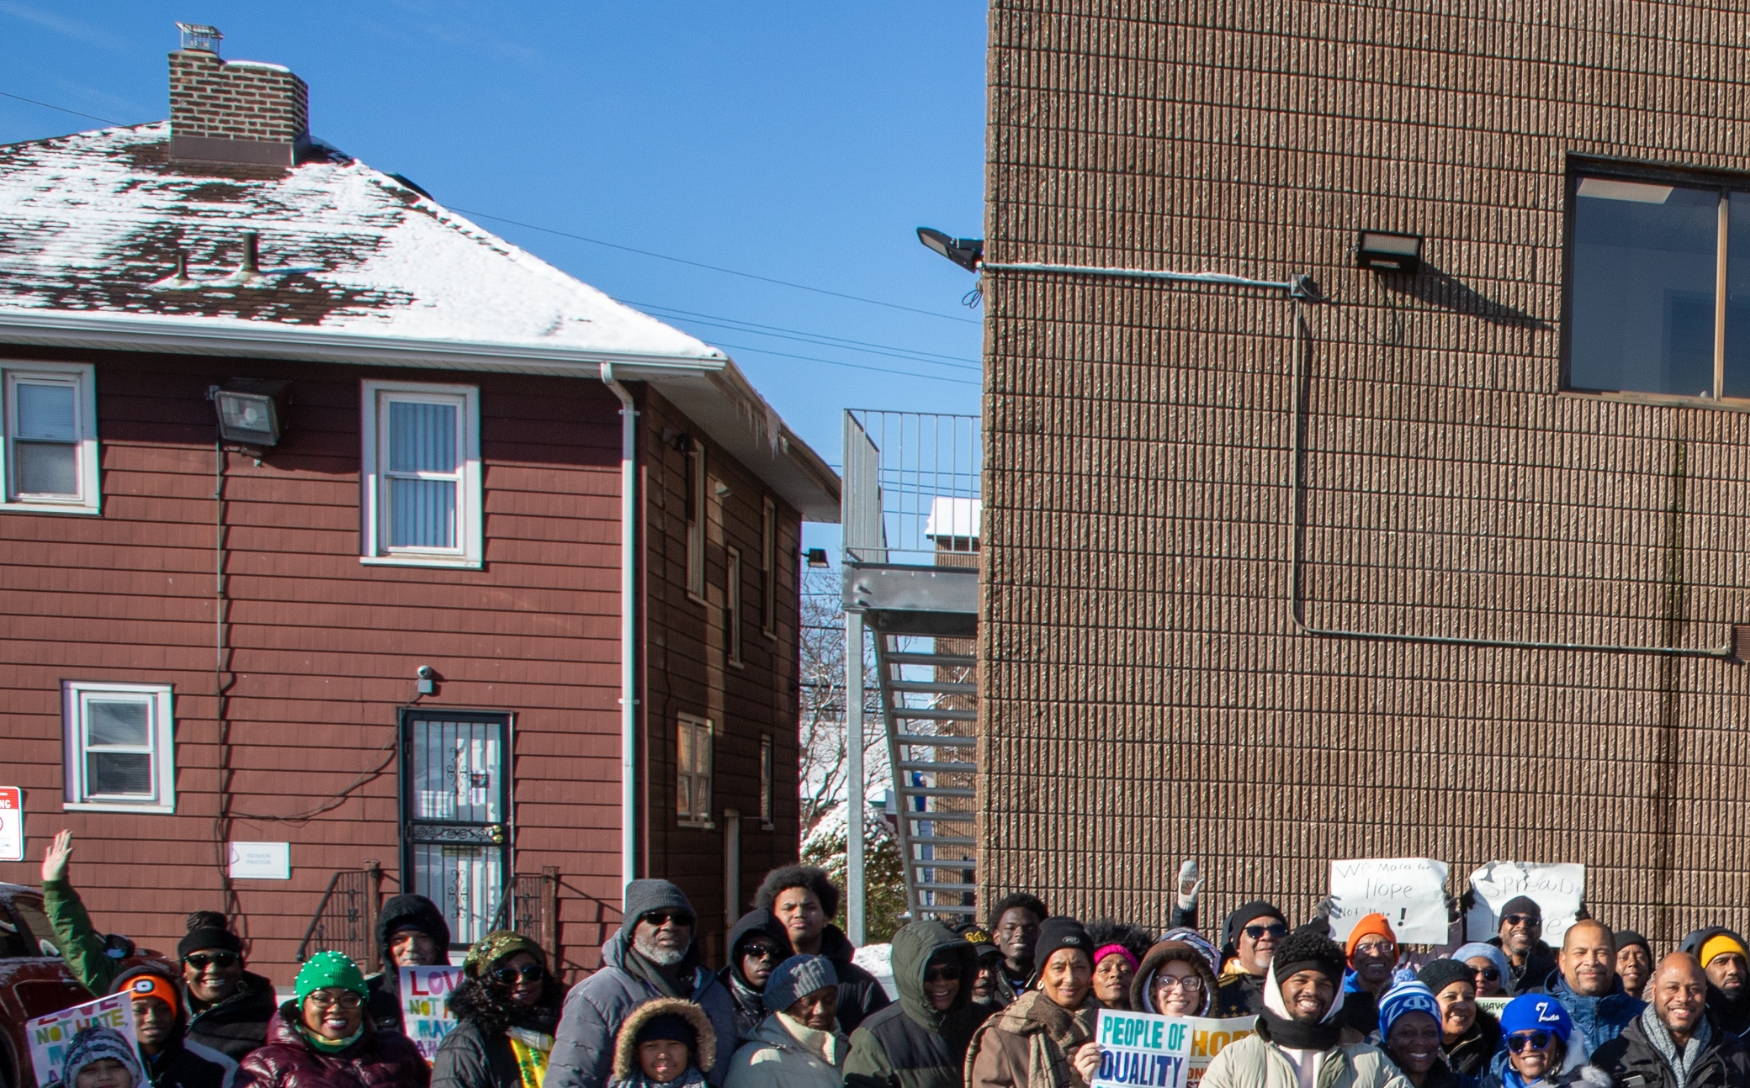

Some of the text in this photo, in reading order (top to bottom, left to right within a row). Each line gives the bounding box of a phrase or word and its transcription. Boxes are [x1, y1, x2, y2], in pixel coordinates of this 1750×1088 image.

[409, 971, 463, 997] LOV
[409, 998, 440, 1016] NOT
[35, 1021, 72, 1045] NOT
[1102, 1016, 1188, 1051] PEOPLE OF
[1099, 1050, 1184, 1088] QUALITY
